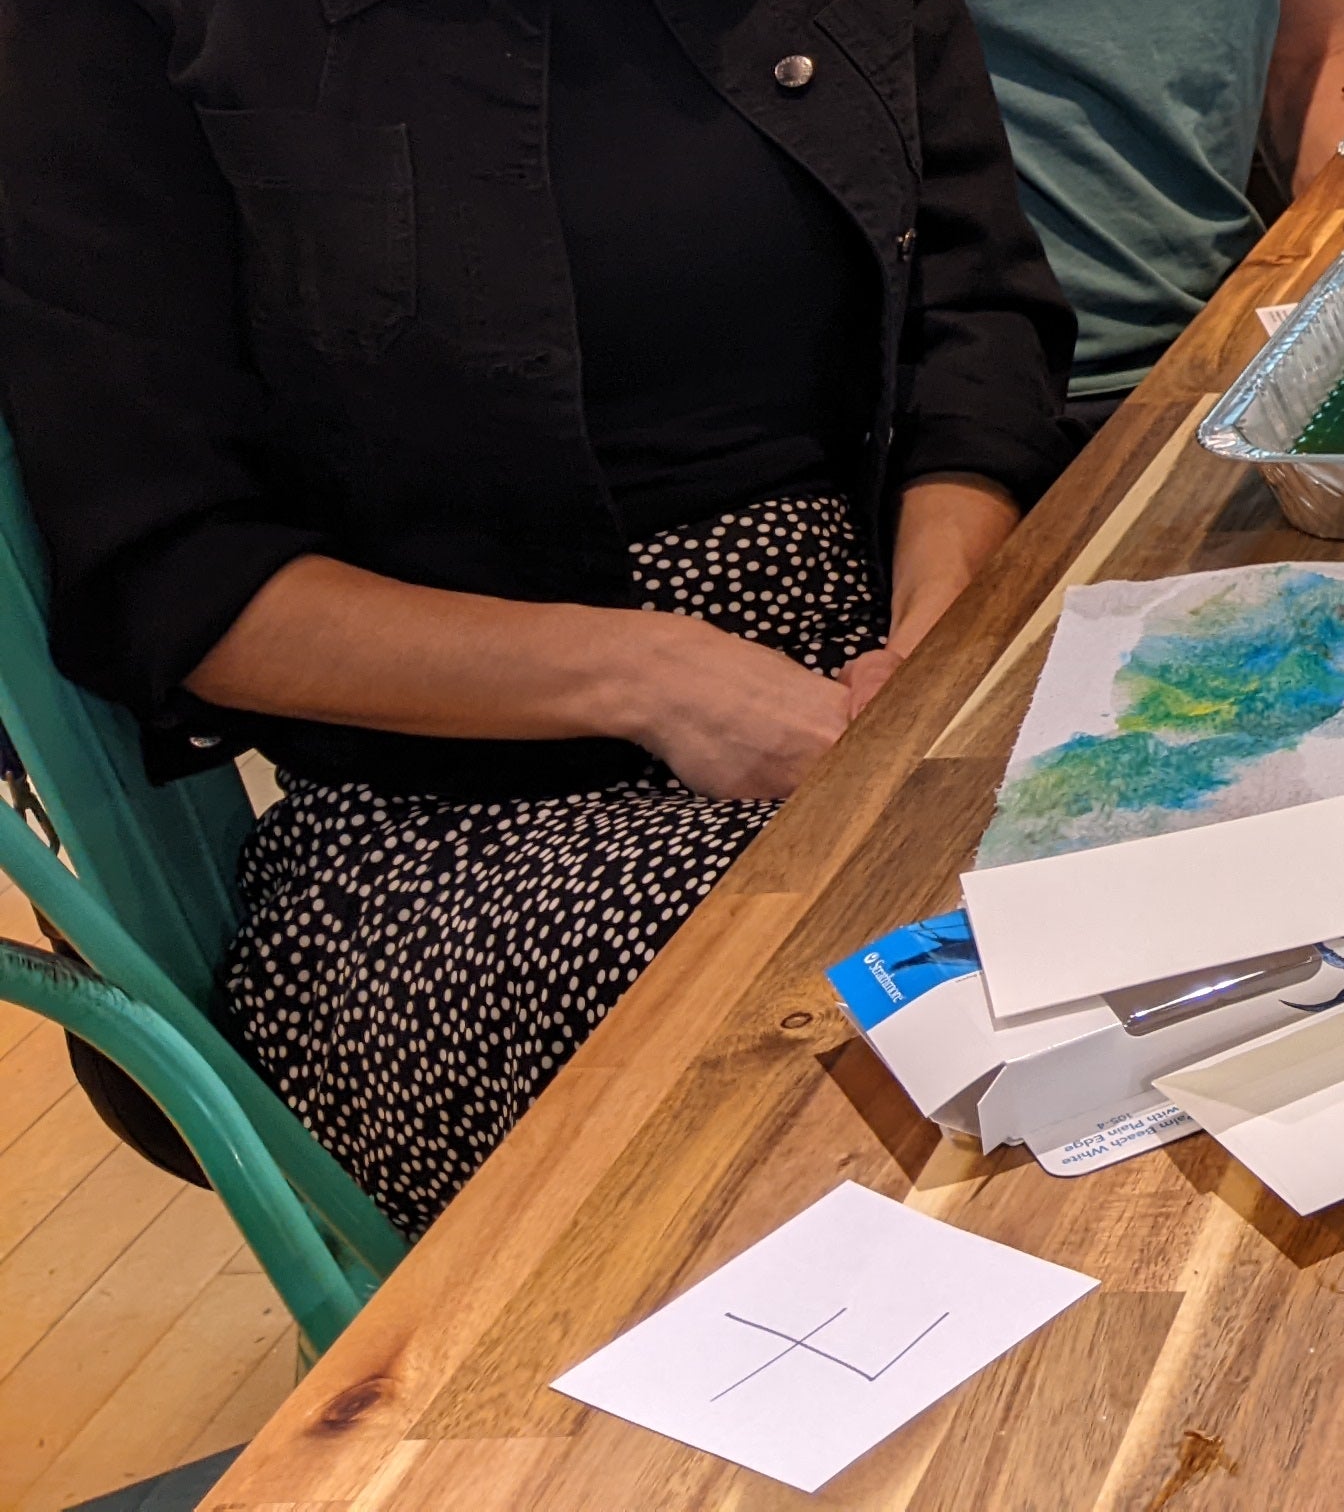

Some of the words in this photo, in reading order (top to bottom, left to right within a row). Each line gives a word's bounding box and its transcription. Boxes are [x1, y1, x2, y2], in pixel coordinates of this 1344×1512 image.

[869, 959, 905, 1003] Strathmore
[1146, 1105, 1180, 1122] with
[1107, 1121, 1144, 1137] Plain
[1110, 1126, 1157, 1147] Beach
[1064, 1134, 1105, 1152] Edge
[1062, 1145, 1109, 1165] White
